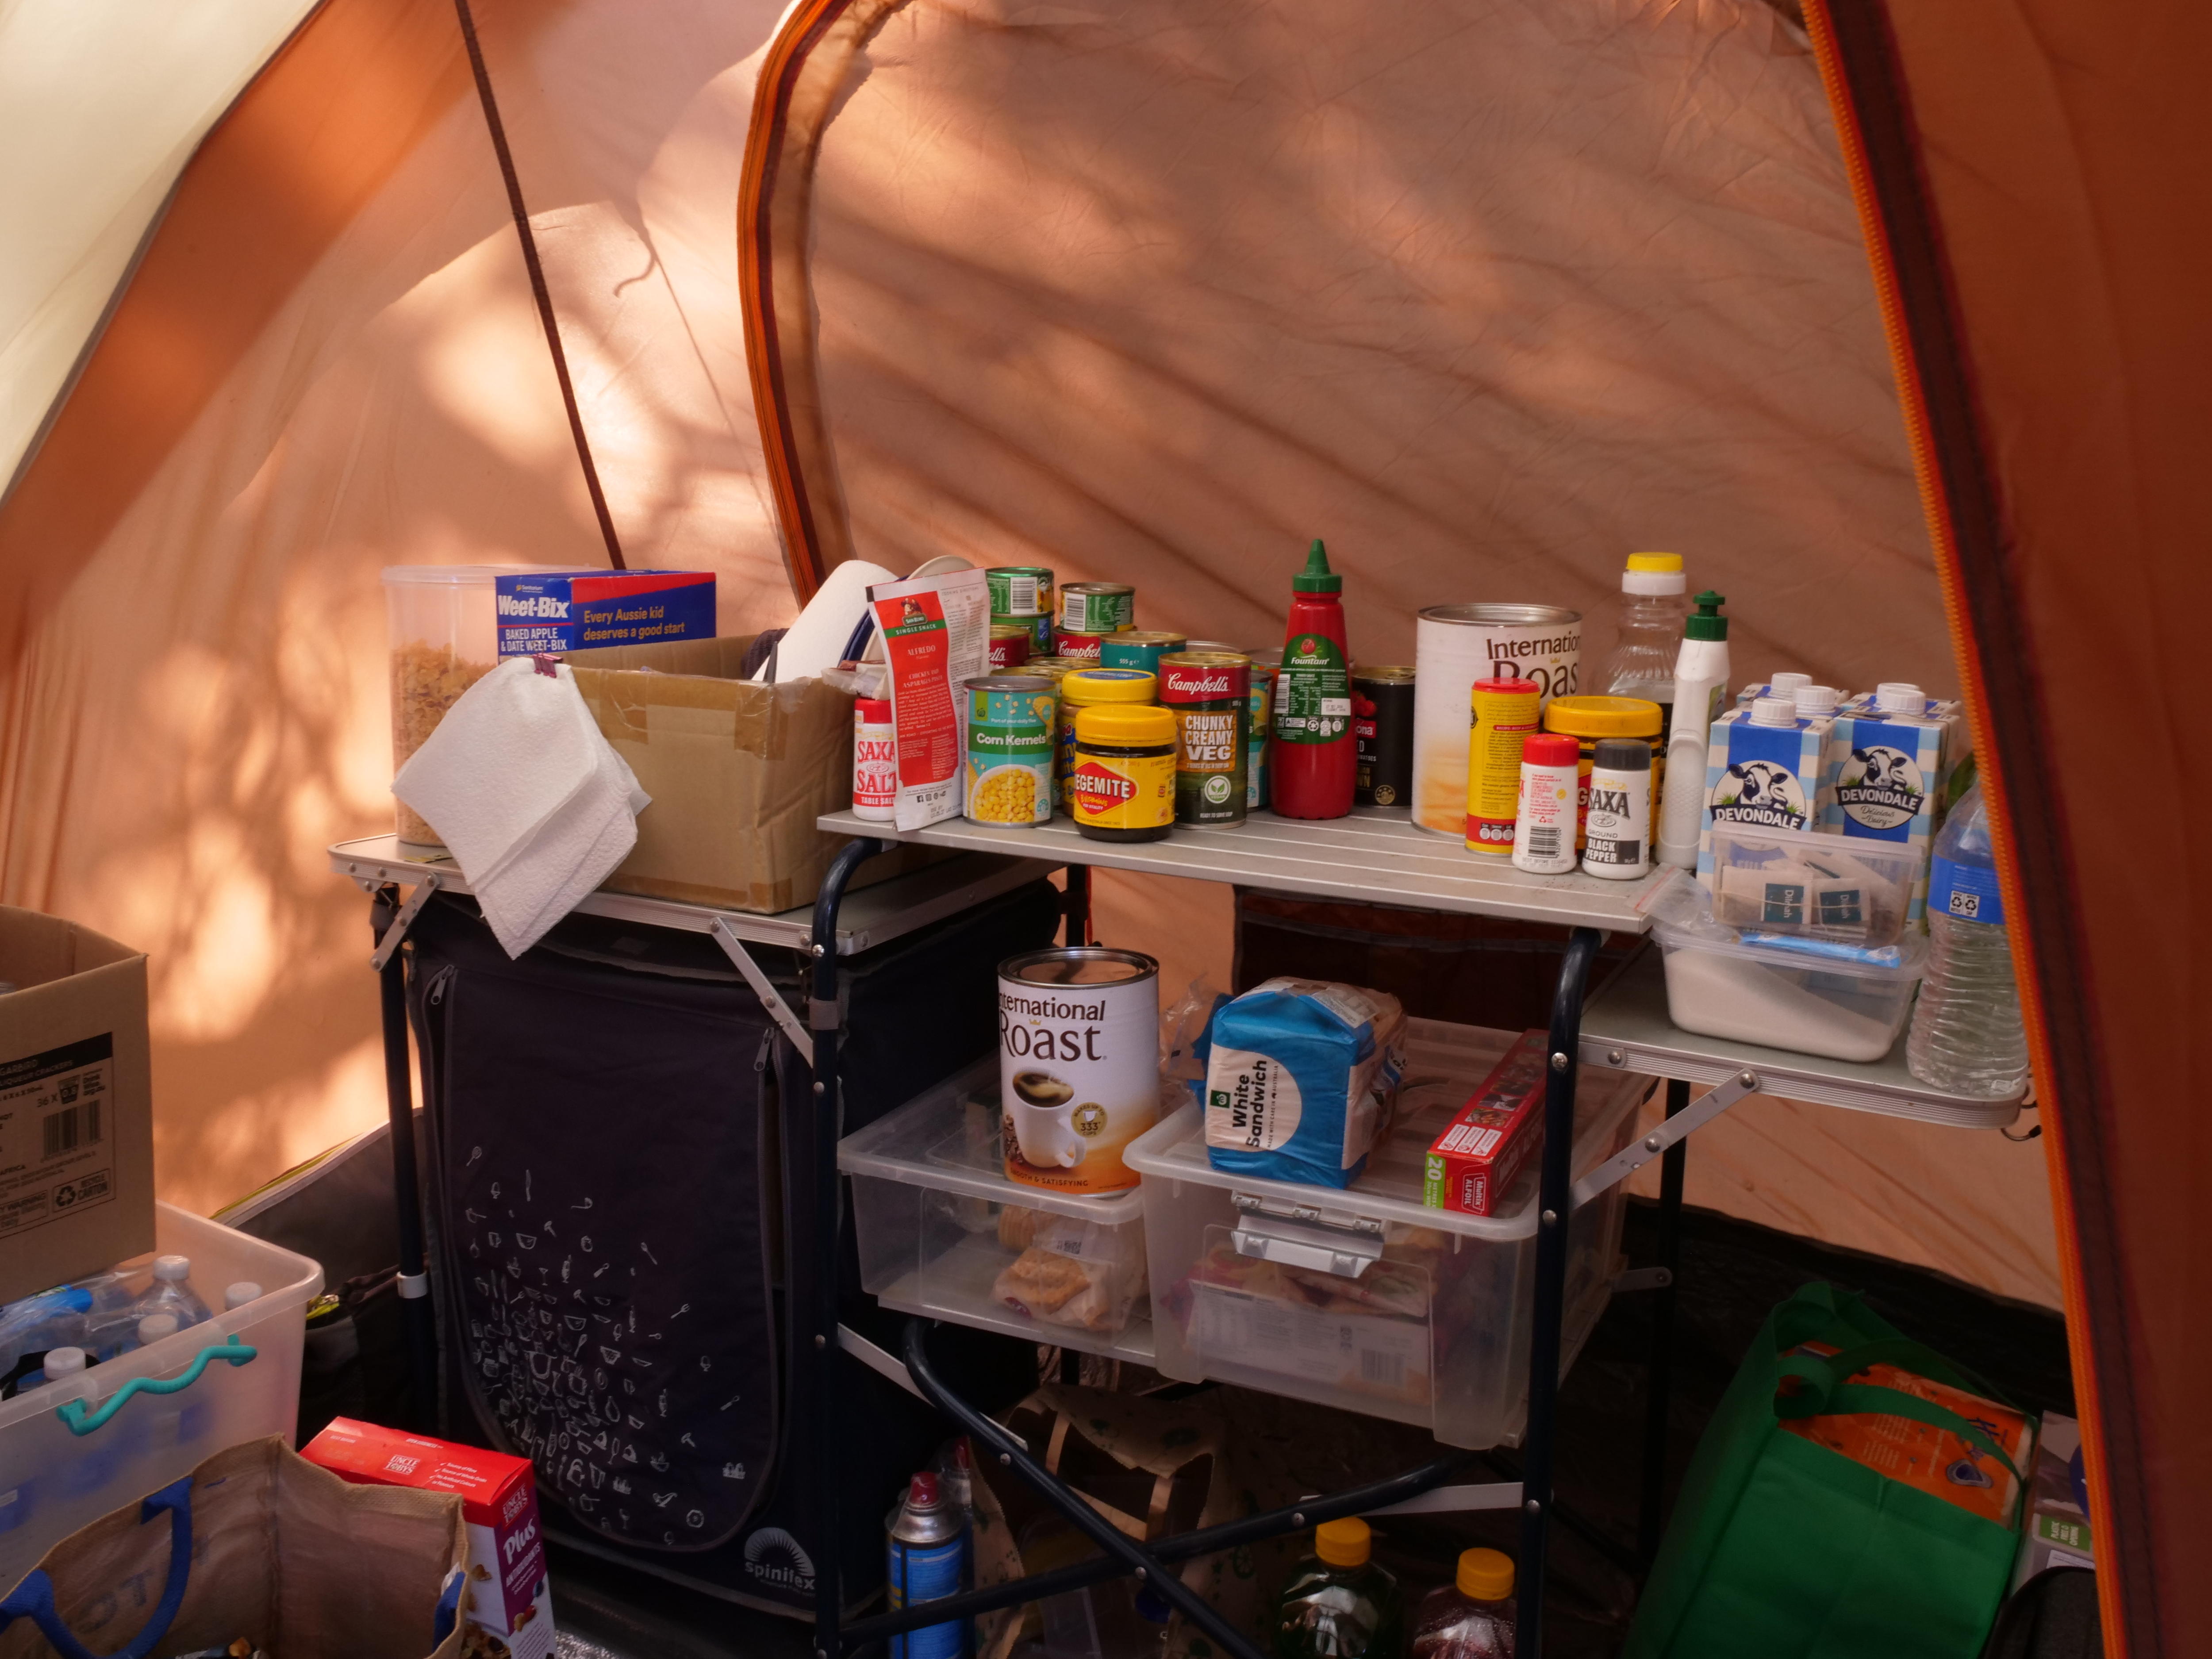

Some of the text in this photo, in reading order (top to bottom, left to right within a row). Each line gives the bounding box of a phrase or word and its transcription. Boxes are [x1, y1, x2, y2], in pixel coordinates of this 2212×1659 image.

[498, 595, 570, 618] Weet-Bix
[584, 605, 664, 625] Every Aussie kid
[505, 628, 558, 640] BAKED APPLE
[584, 622, 685, 641] deserves a good start
[895, 627, 918, 635] SINGLE
[501, 641, 506, 651] &
[507, 641, 525, 651] DATE
[907, 645, 936, 656] ALFREDO
[1291, 655, 1328, 665] Fountain
[1168, 673, 1229, 695] Campbell's
[1185, 715, 1233, 730] CHUNKY
[976, 733, 1046, 745] Corn Kernels
[1185, 730, 1233, 745] CREAMY
[1186, 745, 1231, 760] VEG
[1074, 774, 1131, 798] EGEMITE
[861, 796, 879, 805] TABLE
[1840, 788, 1919, 811] DEVONDALE
[1715, 807, 1800, 830] DEVONDALE
[1588, 838, 1616, 852] BLACK
[1586, 848, 1617, 863] PEPPER
[1000, 1009, 1102, 1062] Roast
[51, 1093, 58, 1103] X
[1232, 1074, 1250, 1128] White
[1245, 1060, 1267, 1148] Sandwich
[1427, 1157, 1443, 1180] 20
[1041, 1178, 1089, 1187] SATISFYING
[1464, 1179, 1473, 1205] ALFOIL
[1475, 1181, 1484, 1206] Multix
[385, 1462, 415, 1474] TOBYS
[391, 1455, 419, 1467] UNCLE
[503, 1486, 527, 1515] UNCLE
[503, 1517, 536, 1565] Plus
[745, 1561, 816, 1590] spinifex
